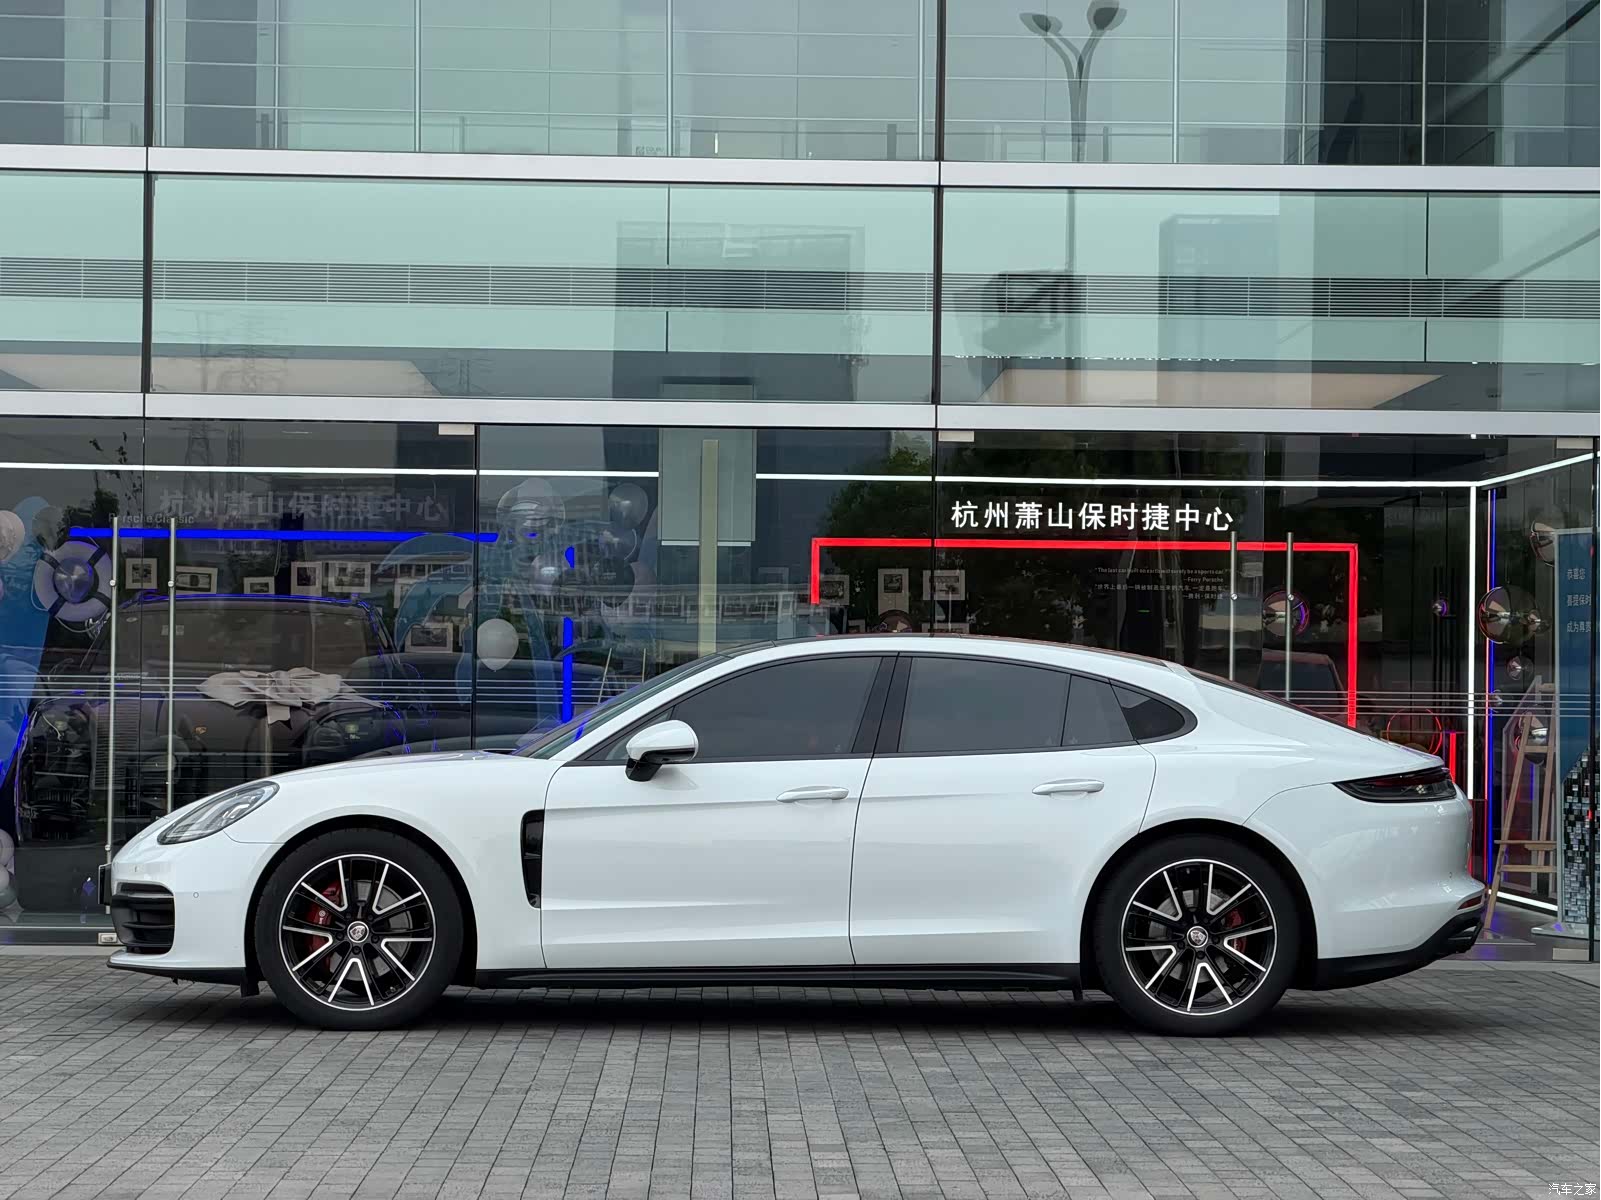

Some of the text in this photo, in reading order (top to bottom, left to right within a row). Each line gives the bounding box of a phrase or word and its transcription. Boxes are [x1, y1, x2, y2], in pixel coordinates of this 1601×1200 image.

[950, 500, 1233, 532] 杭州萧山保时捷中心
